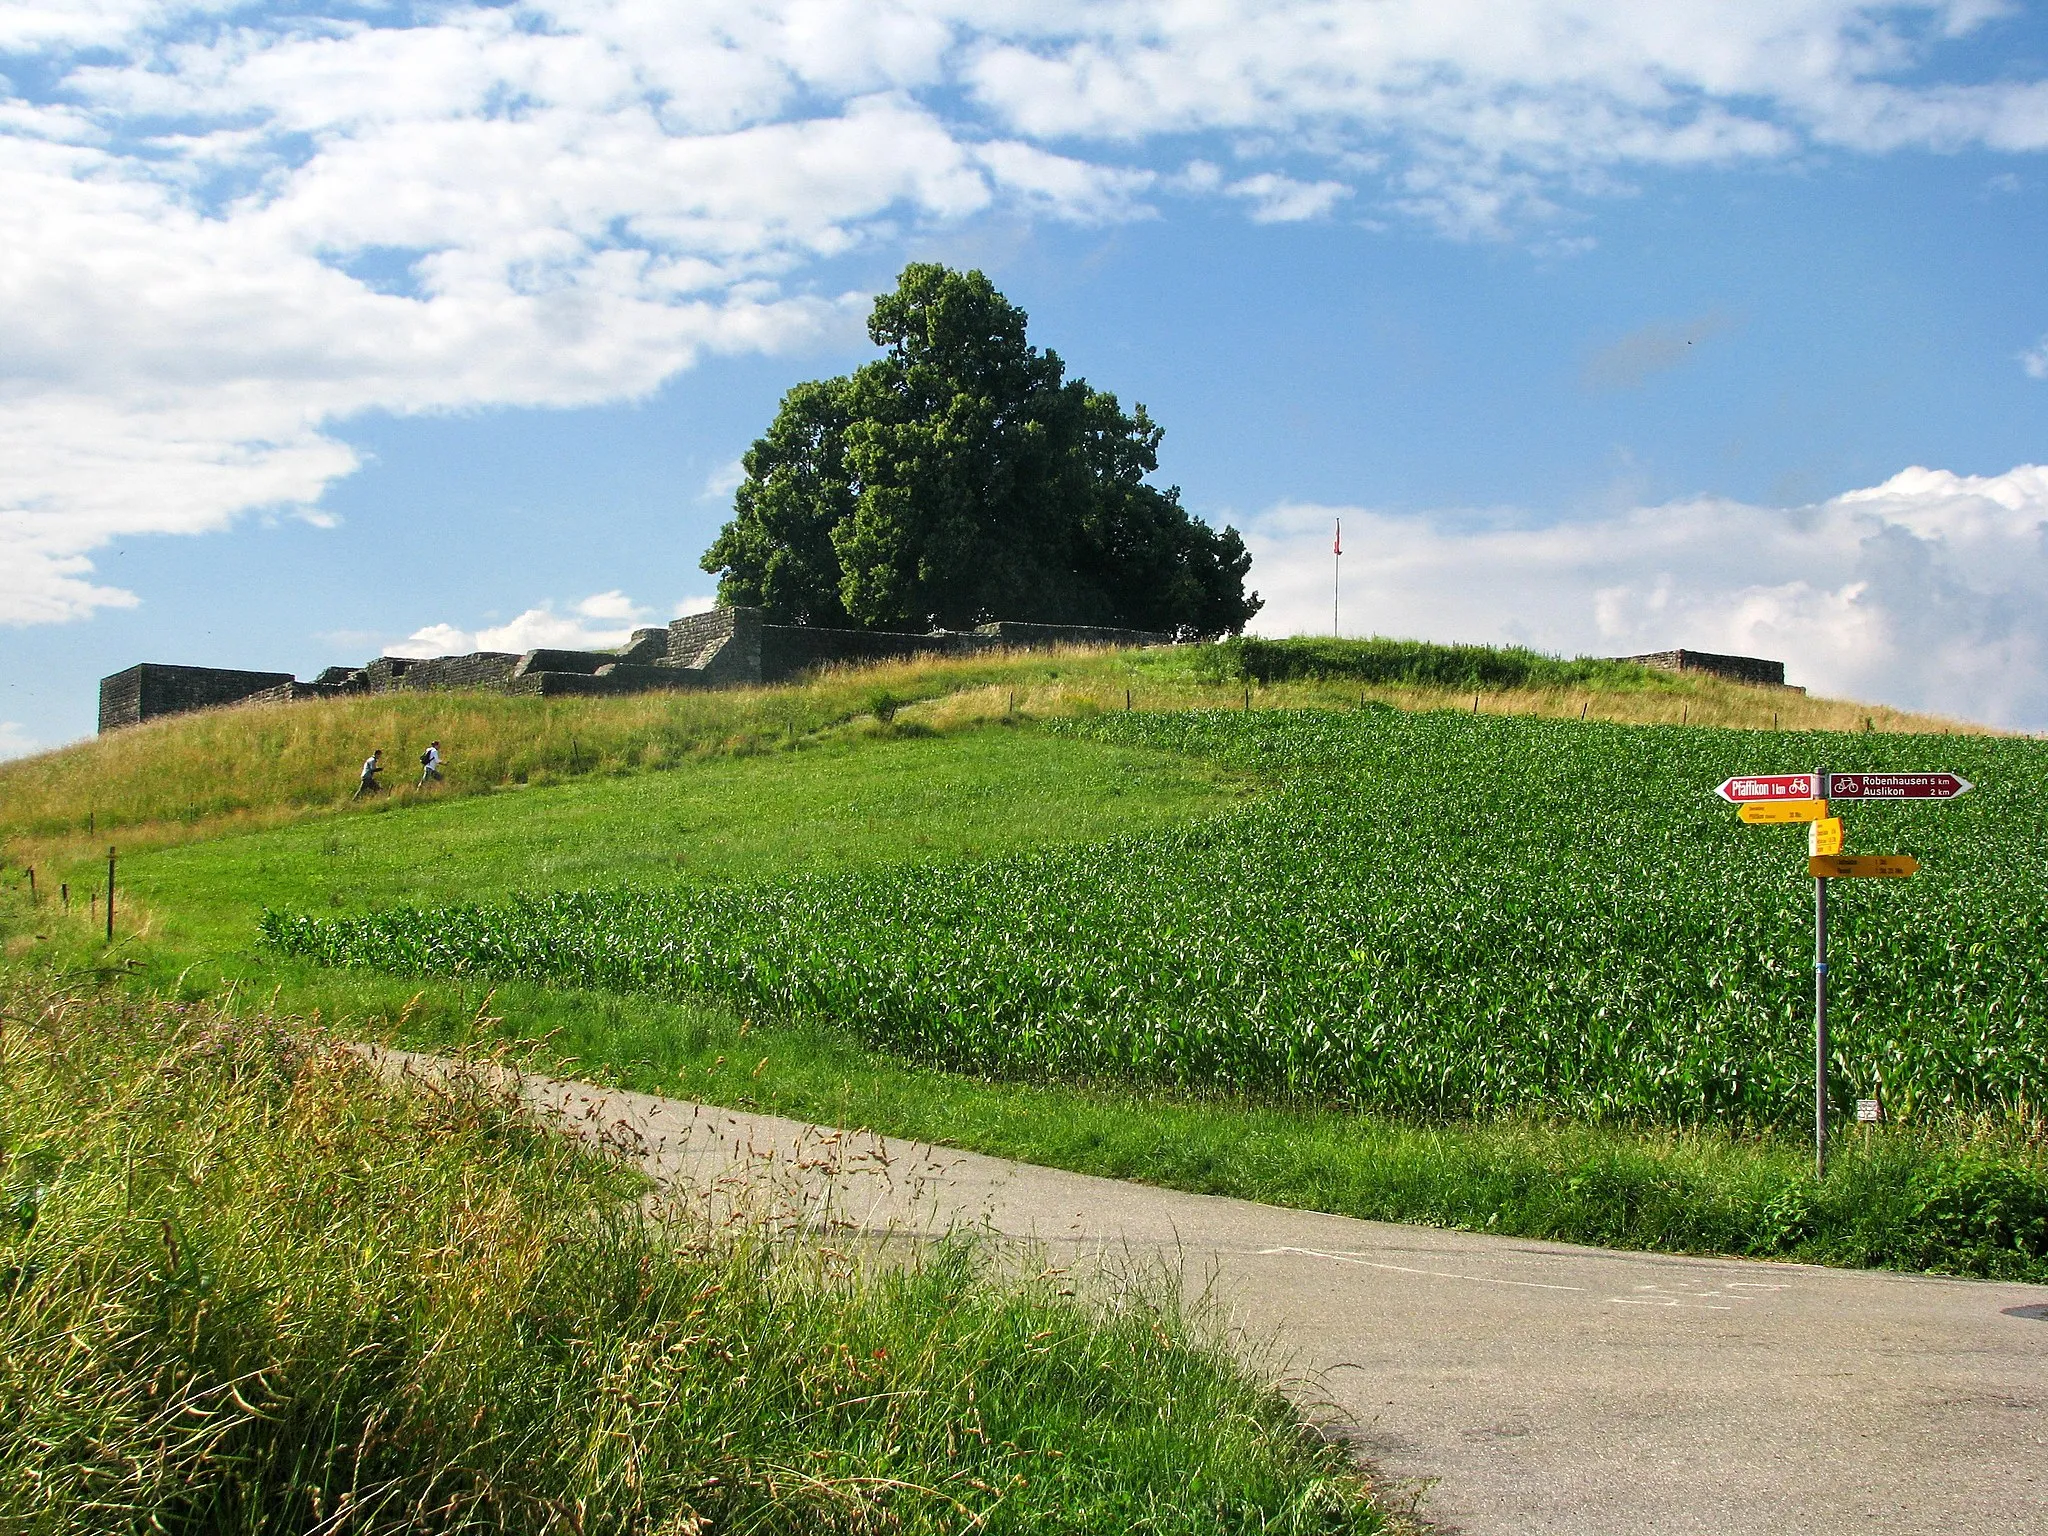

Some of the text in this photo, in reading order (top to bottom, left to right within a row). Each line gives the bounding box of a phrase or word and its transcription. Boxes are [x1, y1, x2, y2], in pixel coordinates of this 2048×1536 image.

[1863, 776, 1928, 785] Robenhausen
[1771, 783, 1775, 795] 1
[1776, 783, 1786, 795] km
[1863, 787, 1905, 796] Auslikon
